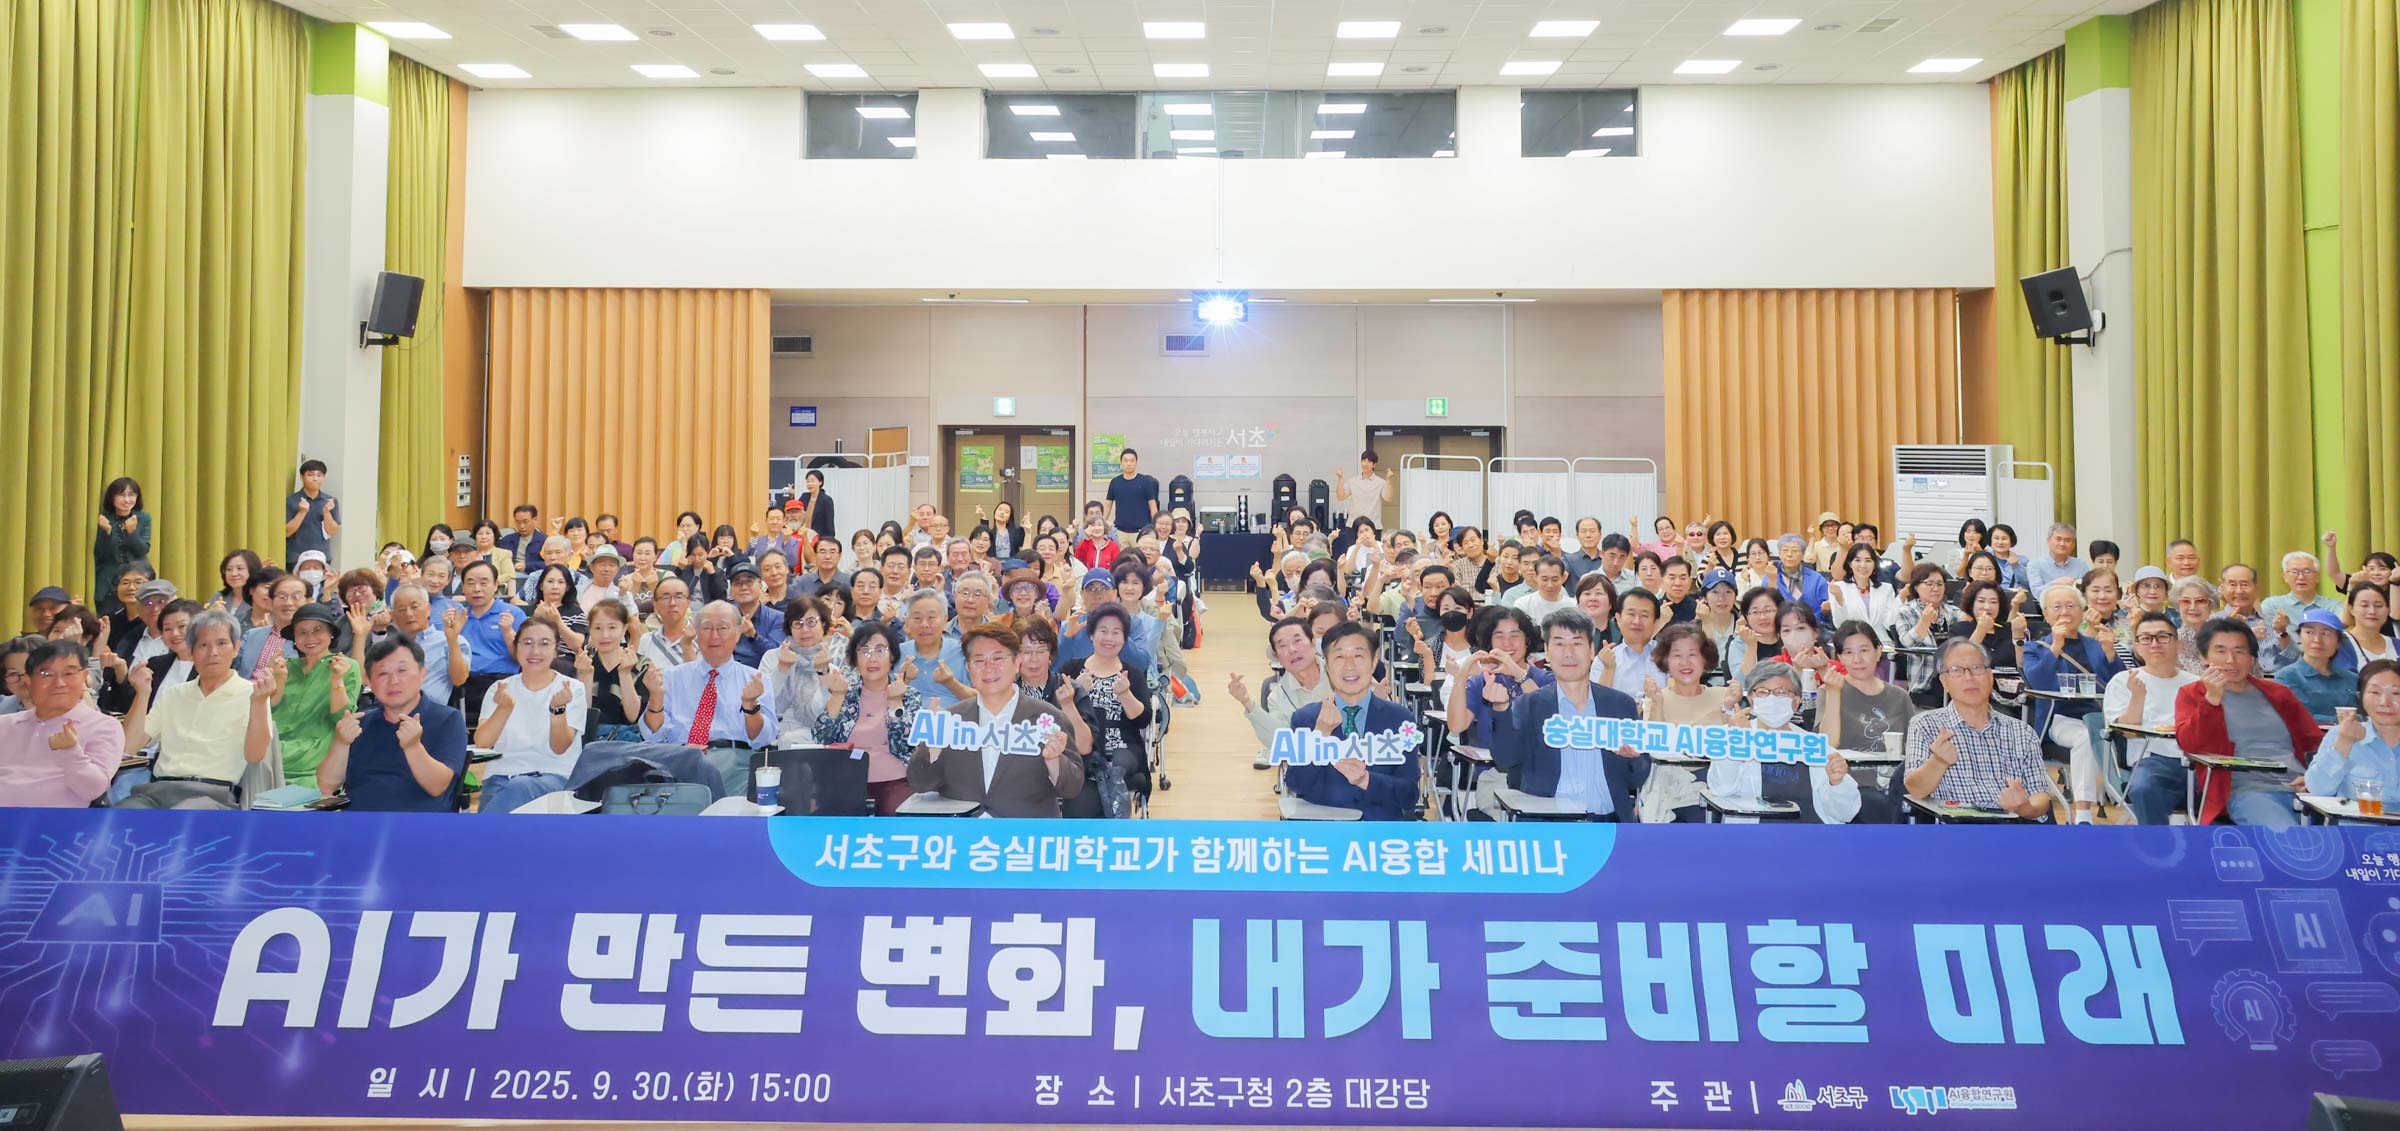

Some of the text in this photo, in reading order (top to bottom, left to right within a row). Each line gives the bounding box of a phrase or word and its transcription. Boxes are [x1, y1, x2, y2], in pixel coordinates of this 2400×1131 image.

[1226, 426, 1267, 449] 서초
[1717, 569, 1726, 578] C
[910, 712, 1039, 753] AI in 서초
[1271, 730, 1403, 764] AI in 서초
[1544, 715, 1828, 764] 숭실대학교 AI융합연구원
[815, 833, 1569, 877] 서초구와 숭실대학교가 함께하는 AI융합 세미나
[2361, 853, 2385, 866] 오늘
[2345, 868, 2382, 881] 내일이
[57, 892, 143, 927] AI
[2294, 913, 2327, 949] AI
[211, 906, 2186, 1050] AI가 만든 변화, 내가 준비할 미래
[2243, 999, 2263, 1021] AI
[366, 1067, 397, 1099] 일
[418, 1068, 448, 1100] 시
[490, 1069, 578, 1100] 2025.
[592, 1071, 618, 1101] 9.
[632, 1071, 736, 1102] 30.(화)
[749, 1073, 831, 1103] 15:00
[1034, 1074, 1063, 1106] 장
[1088, 1075, 1115, 1106] 소
[1159, 1076, 1273, 1108] 서초구청
[1286, 1077, 1333, 1109] 2층
[1345, 1078, 1431, 1110] 대강당
[1650, 1080, 1680, 1112] 주
[1703, 1081, 1733, 1113] 관
[1817, 1085, 1868, 1109] 서초구
[1949, 1086, 2015, 1101] AI융합연구원
